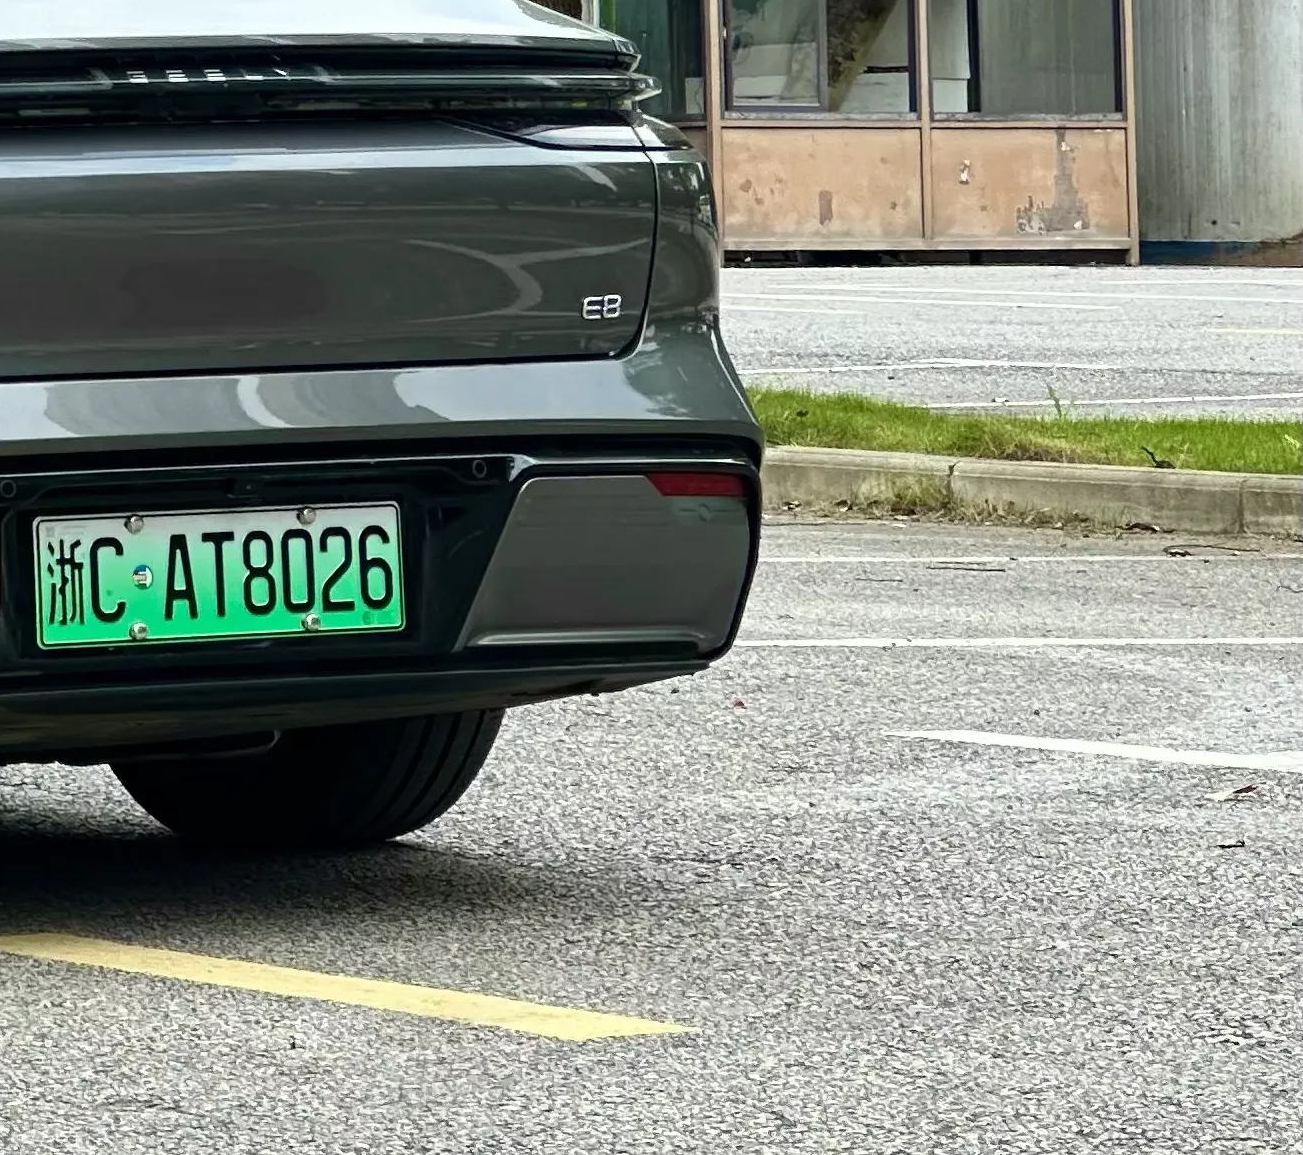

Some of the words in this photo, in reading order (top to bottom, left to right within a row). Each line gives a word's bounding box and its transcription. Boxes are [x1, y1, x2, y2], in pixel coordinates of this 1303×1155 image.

[582, 294, 622, 320] E8
[46, 536, 127, 626] 浙C
[163, 524, 395, 621] AT8026
